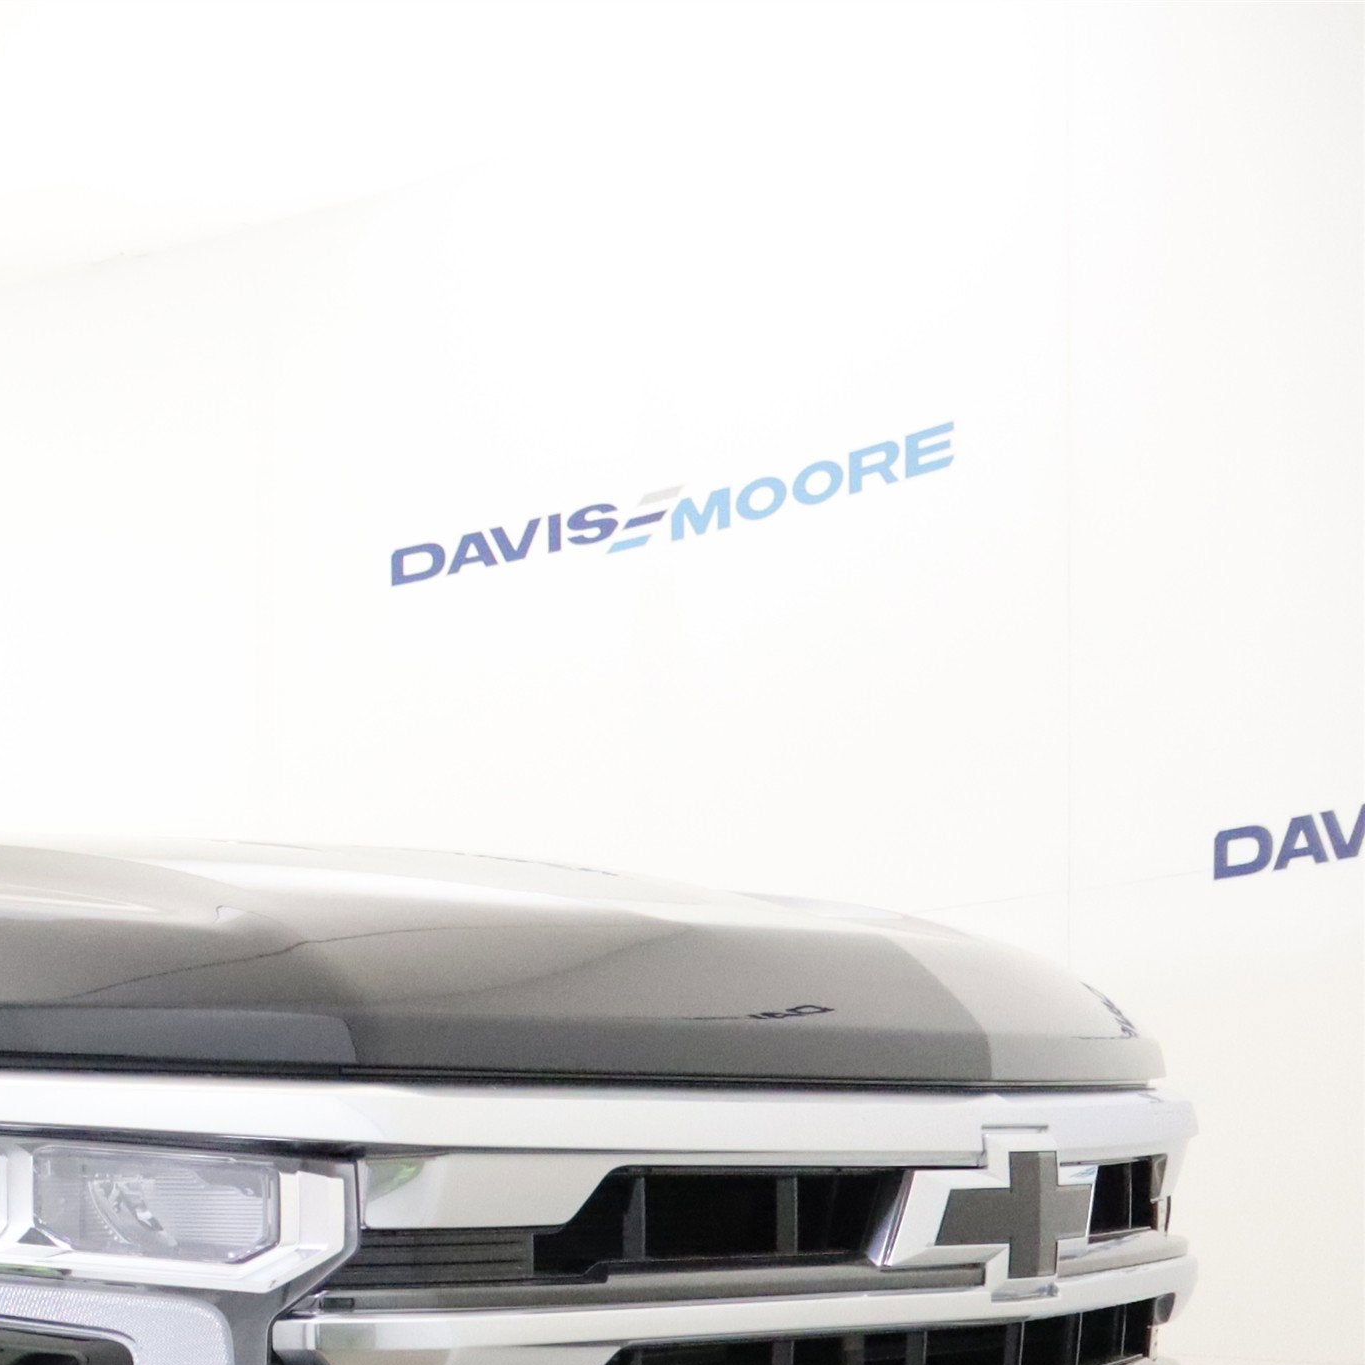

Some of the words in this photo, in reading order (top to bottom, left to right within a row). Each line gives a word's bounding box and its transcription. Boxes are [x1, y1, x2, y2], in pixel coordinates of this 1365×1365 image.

[390, 503, 618, 586] DAVIS
[670, 421, 955, 541] MOORE
[1213, 803, 1365, 880] DAV
